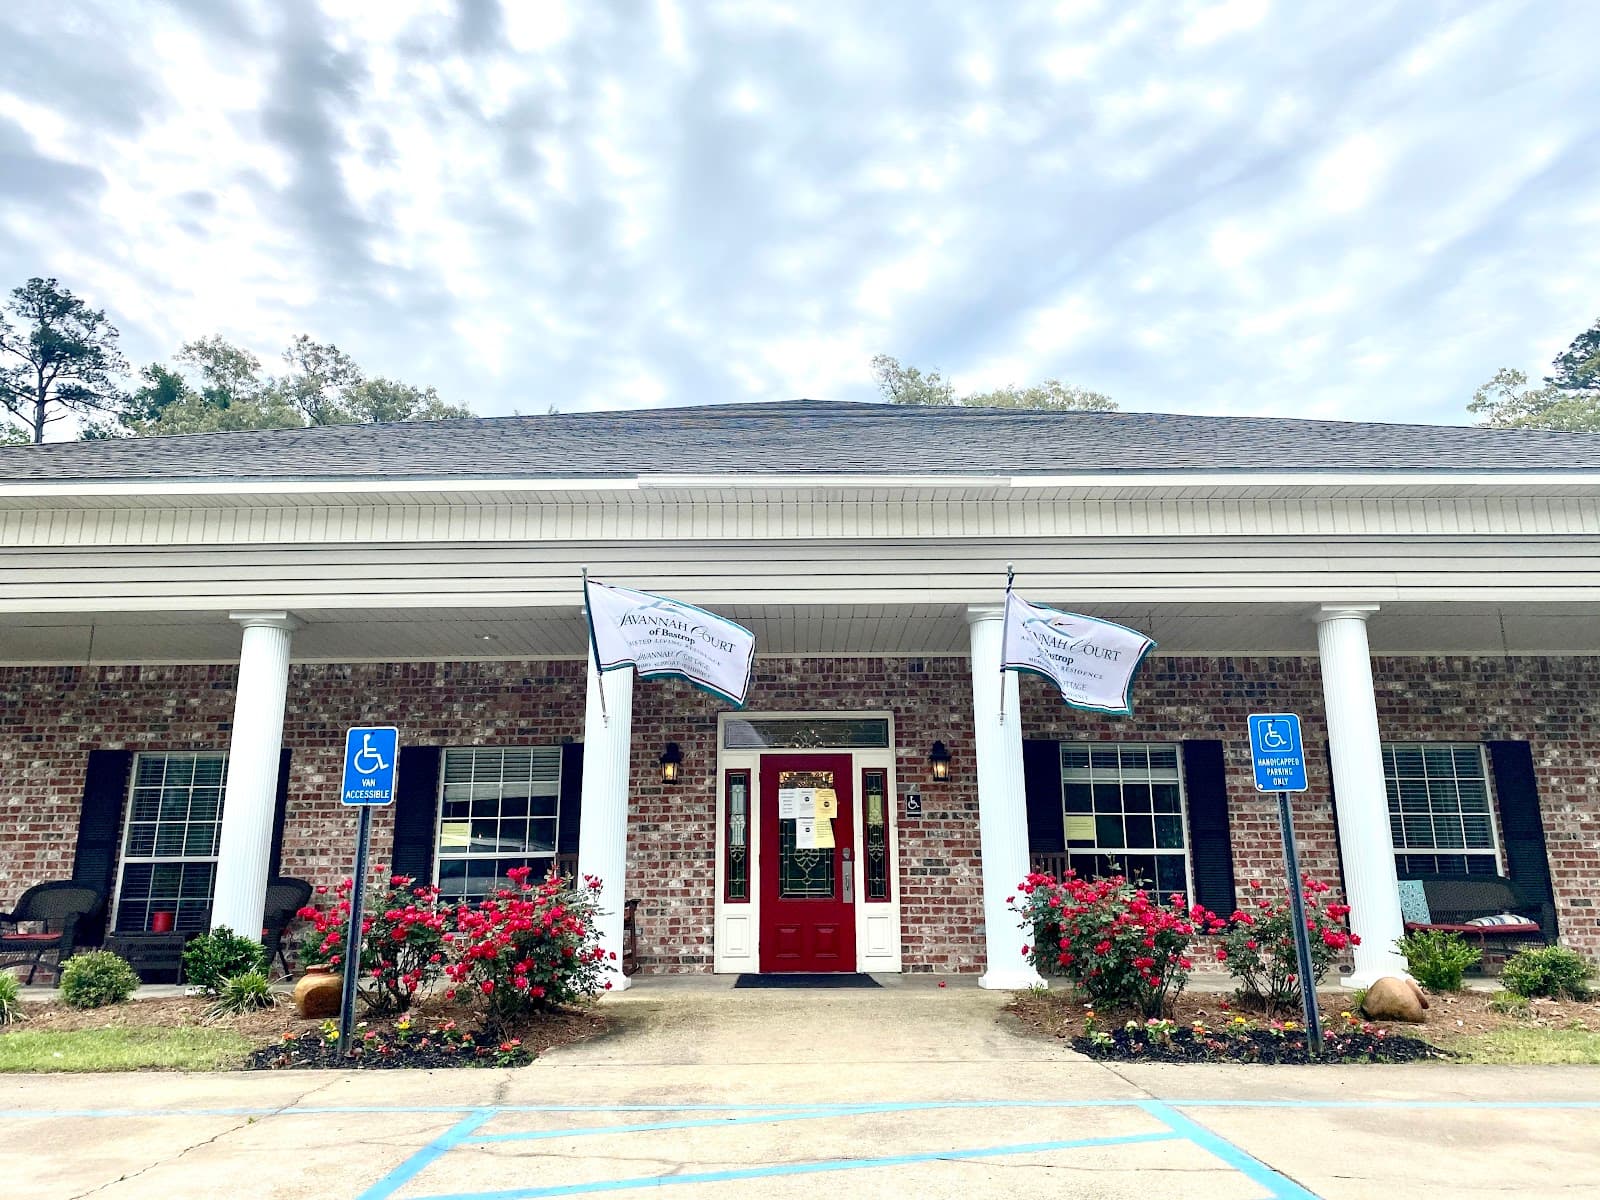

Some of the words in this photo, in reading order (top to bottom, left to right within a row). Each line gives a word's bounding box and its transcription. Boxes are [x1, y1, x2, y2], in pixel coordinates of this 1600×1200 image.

[649, 628, 661, 637] of
[662, 628, 696, 645] Bastrop
[690, 625, 736, 652] COURT
[1070, 639, 1122, 662] COURT
[1257, 757, 1299, 766] HANDICAPPED
[1266, 767, 1293, 776] PARKING
[361, 778, 376, 787] VAN
[1273, 778, 1288, 786] ONLY
[345, 789, 390, 799] ACCESSIBLE
